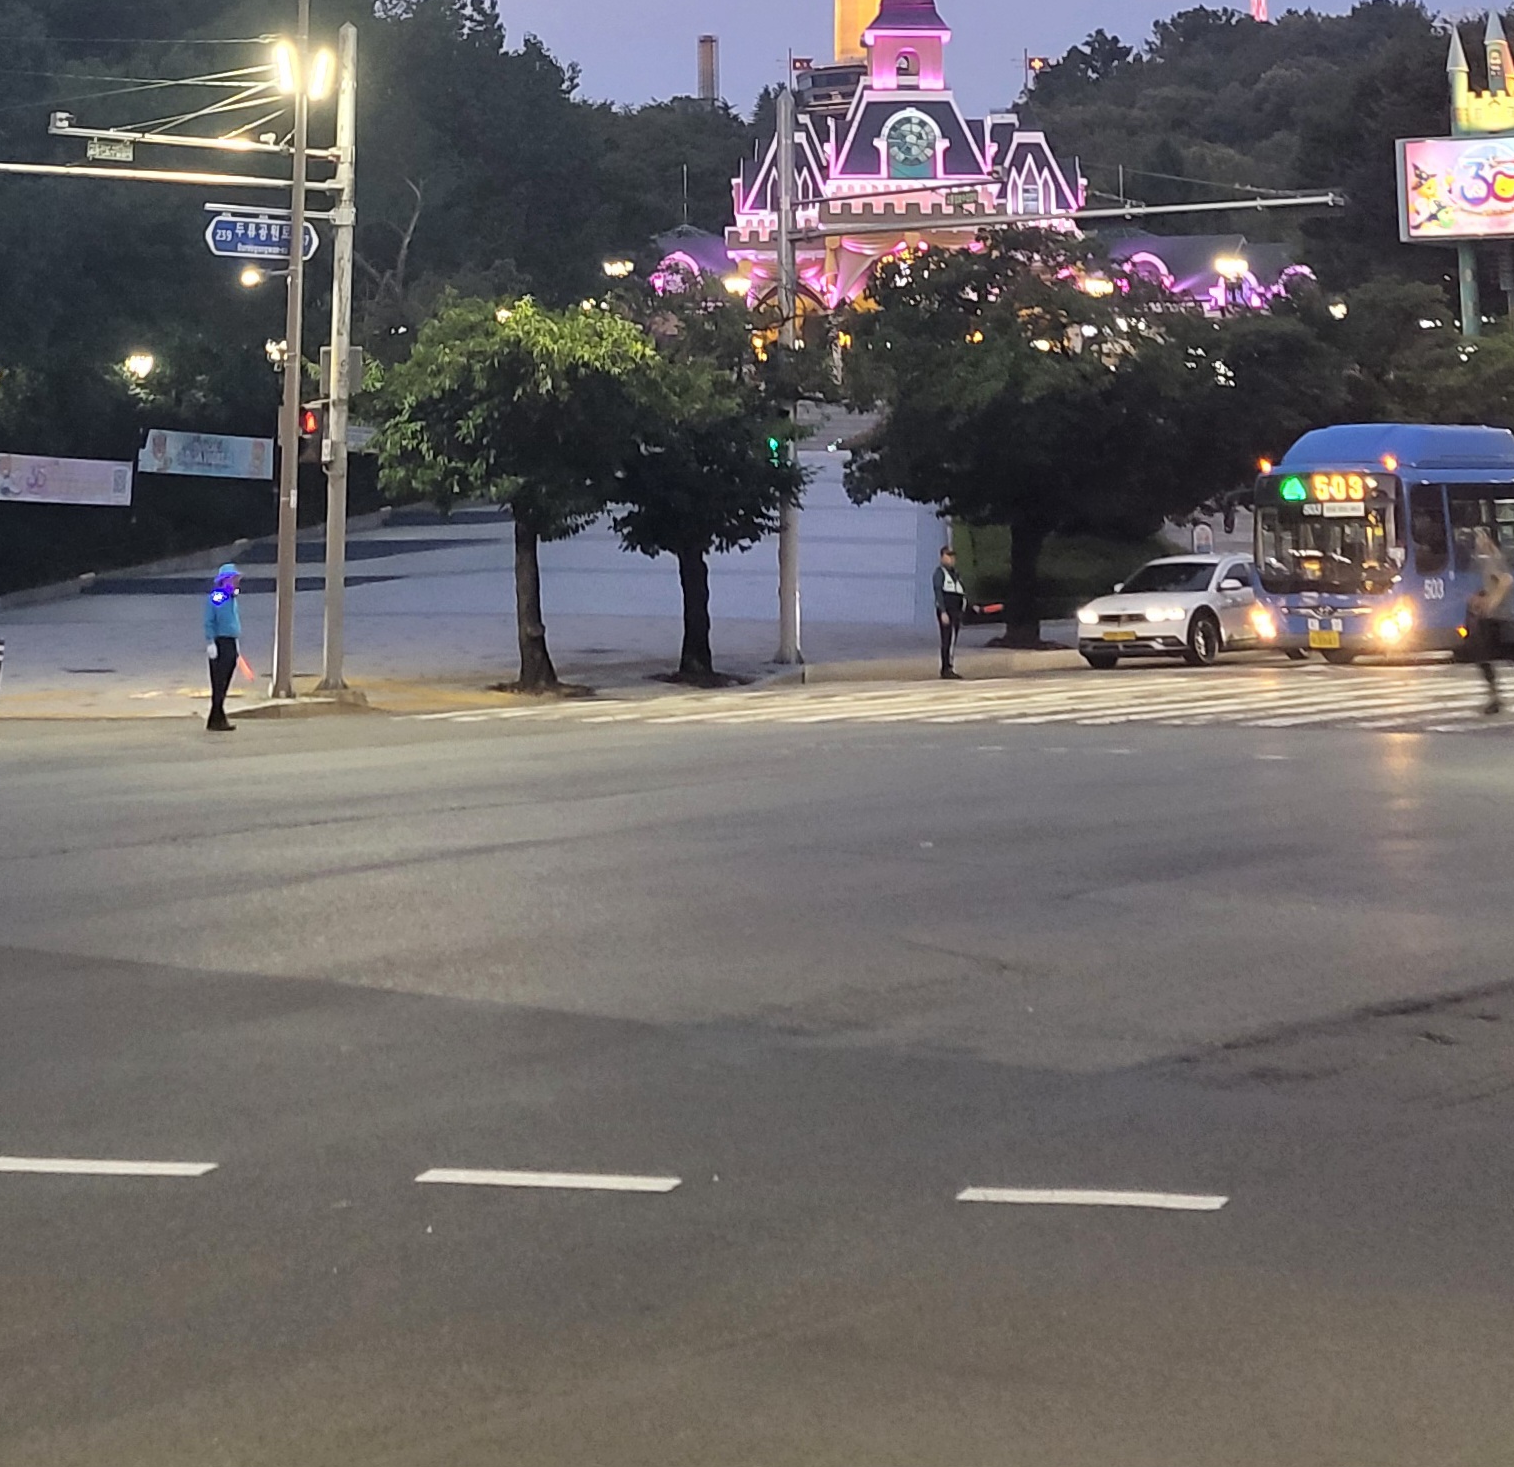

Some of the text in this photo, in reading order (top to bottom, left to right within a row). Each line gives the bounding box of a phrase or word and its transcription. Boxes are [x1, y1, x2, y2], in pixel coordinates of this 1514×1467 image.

[215, 229, 233, 242] 239
[1312, 474, 1365, 501] 503
[1423, 578, 1445, 600] 503
